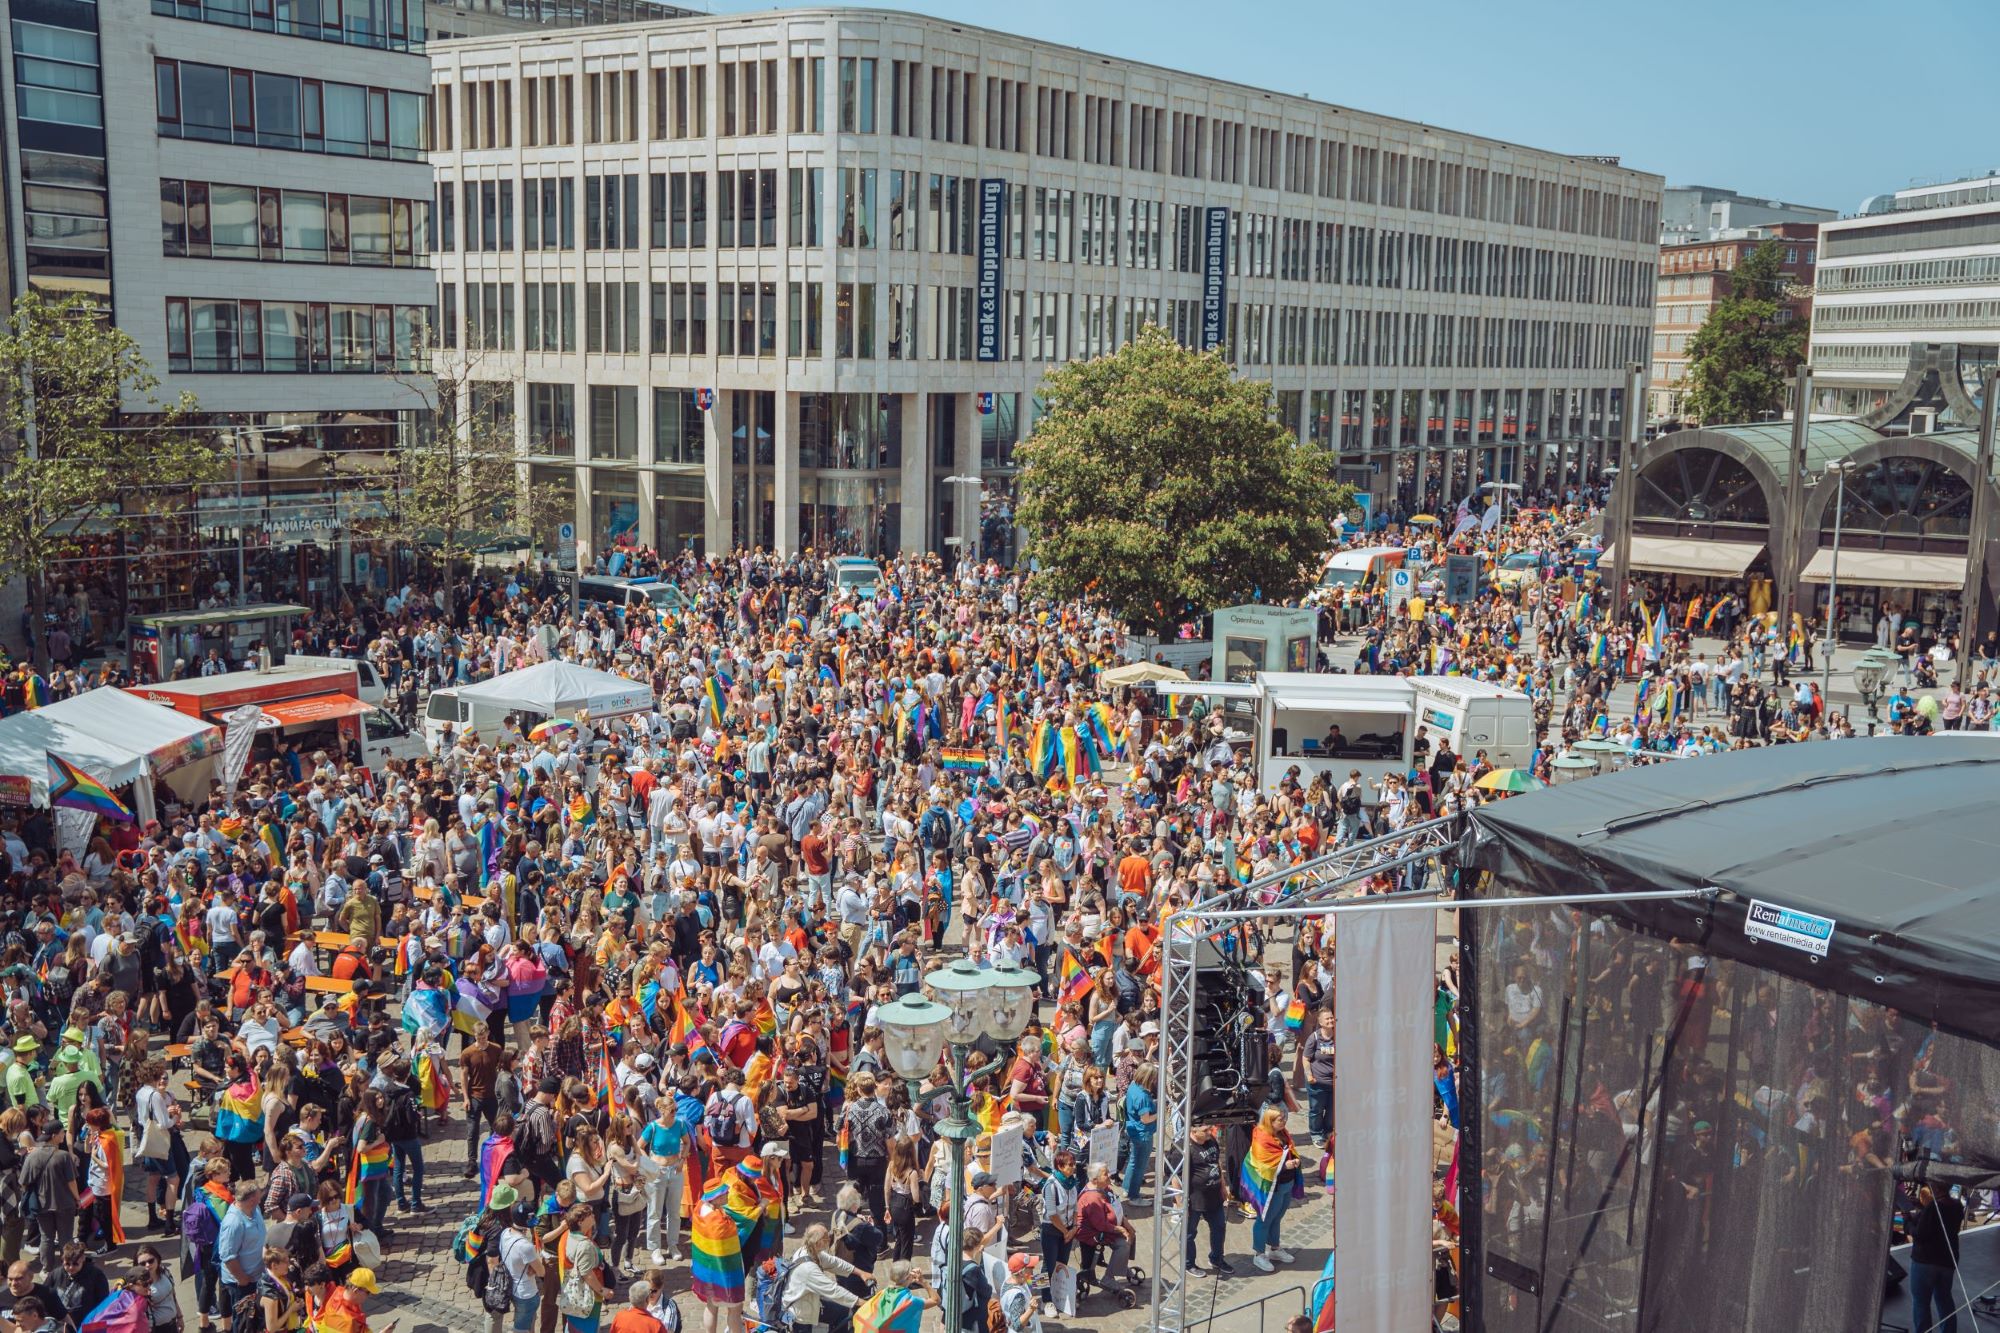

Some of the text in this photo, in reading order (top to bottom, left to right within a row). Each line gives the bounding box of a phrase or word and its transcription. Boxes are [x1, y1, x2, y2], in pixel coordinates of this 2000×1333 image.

[979, 182, 1001, 359] Peek&Cloppenburg
[1205, 210, 1226, 351] eek&Cloppenburg
[1230, 613, 1265, 626] Opernhaus
[132, 638, 157, 654] KFC
[1752, 905, 1825, 935] Rentalmedia
[1746, 924, 1826, 952] www.rentalmedia.de
